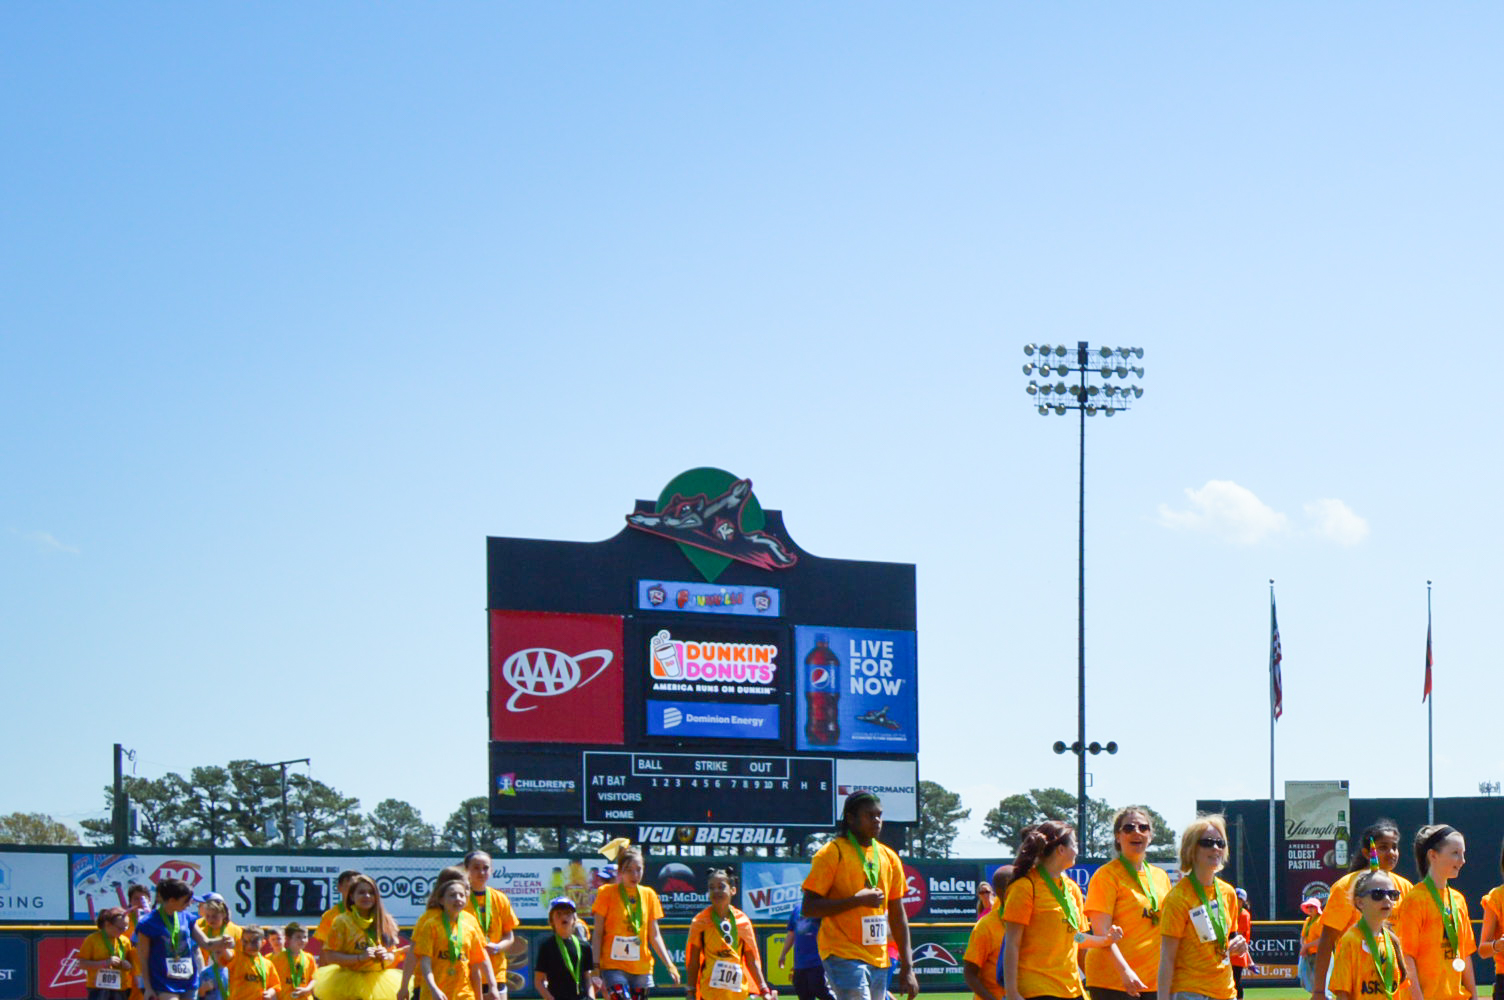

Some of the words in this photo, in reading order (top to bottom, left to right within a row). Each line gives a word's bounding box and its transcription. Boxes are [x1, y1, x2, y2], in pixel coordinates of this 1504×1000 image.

[687, 644, 776, 663] DUNKIN'
[850, 639, 894, 659] LIVE
[511, 650, 573, 694] AAA
[686, 662, 772, 681] DONUTS
[850, 658, 893, 677] FOR
[653, 683, 693, 692] AMERICA
[695, 684, 719, 693] RUNS
[850, 678, 903, 695] NOW
[686, 714, 730, 725] Dominion
[731, 715, 764, 727] Energy
[638, 759, 662, 770] BALL
[695, 761, 728, 772] STRIKE
[750, 762, 772, 772] OUT
[515, 779, 575, 788] CHILDREN'S
[592, 775, 604, 786] AT
[607, 775, 625, 786] BAT
[598, 792, 642, 801] VISITORS
[605, 810, 634, 819] HOME
[638, 826, 677, 843] VCU
[695, 828, 787, 844] BASEBALL
[1287, 819, 1339, 838] Yuenglin
[1288, 850, 1316, 859] OLDEST
[1288, 860, 1323, 870] PASTIME.
[493, 866, 539, 884] Wegmans
[930, 877, 975, 894] haley
[1248, 939, 1295, 951] RGENT
[719, 969, 737, 984] 104
